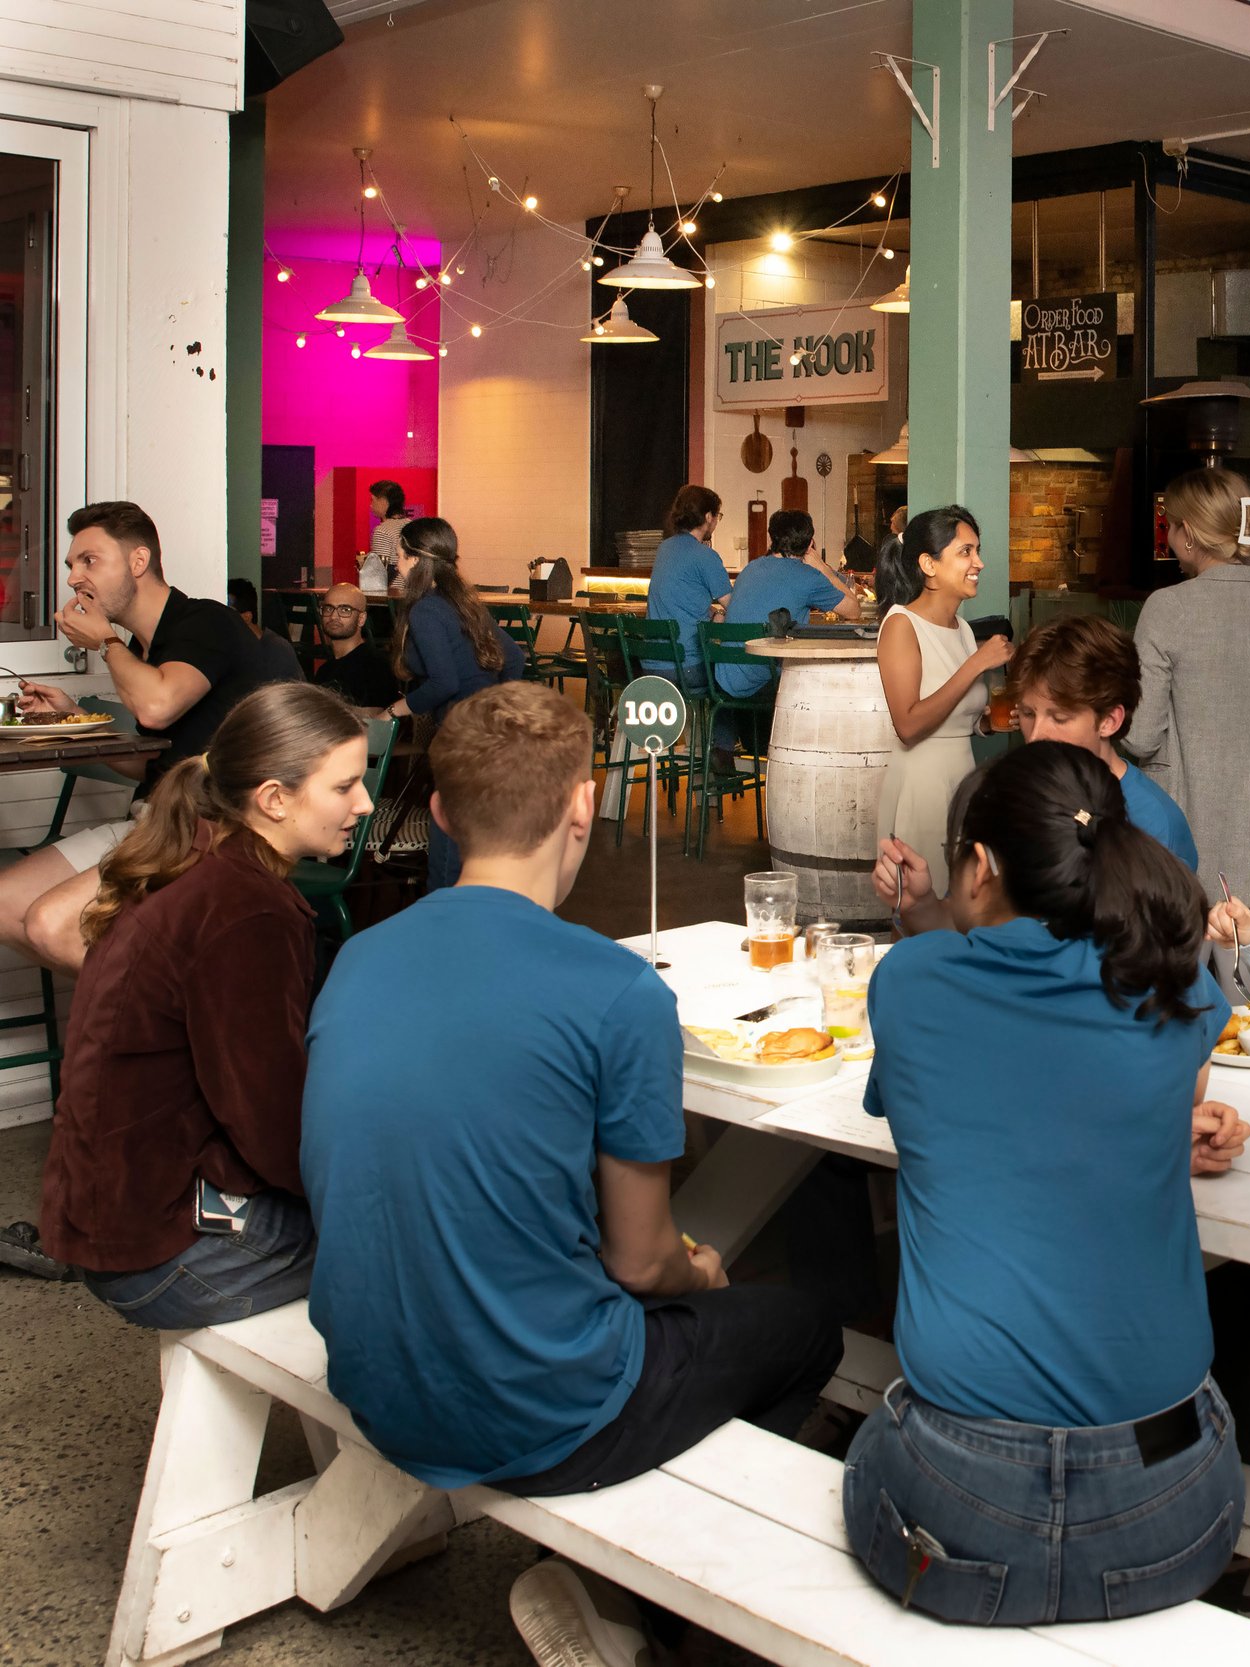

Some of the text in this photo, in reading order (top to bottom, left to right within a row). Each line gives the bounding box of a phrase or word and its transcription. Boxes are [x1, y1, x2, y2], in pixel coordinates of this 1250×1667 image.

[725, 329, 876, 383] THE NOOK
[1022, 329, 1111, 371] AT BAR
[625, 701, 678, 726] 100
